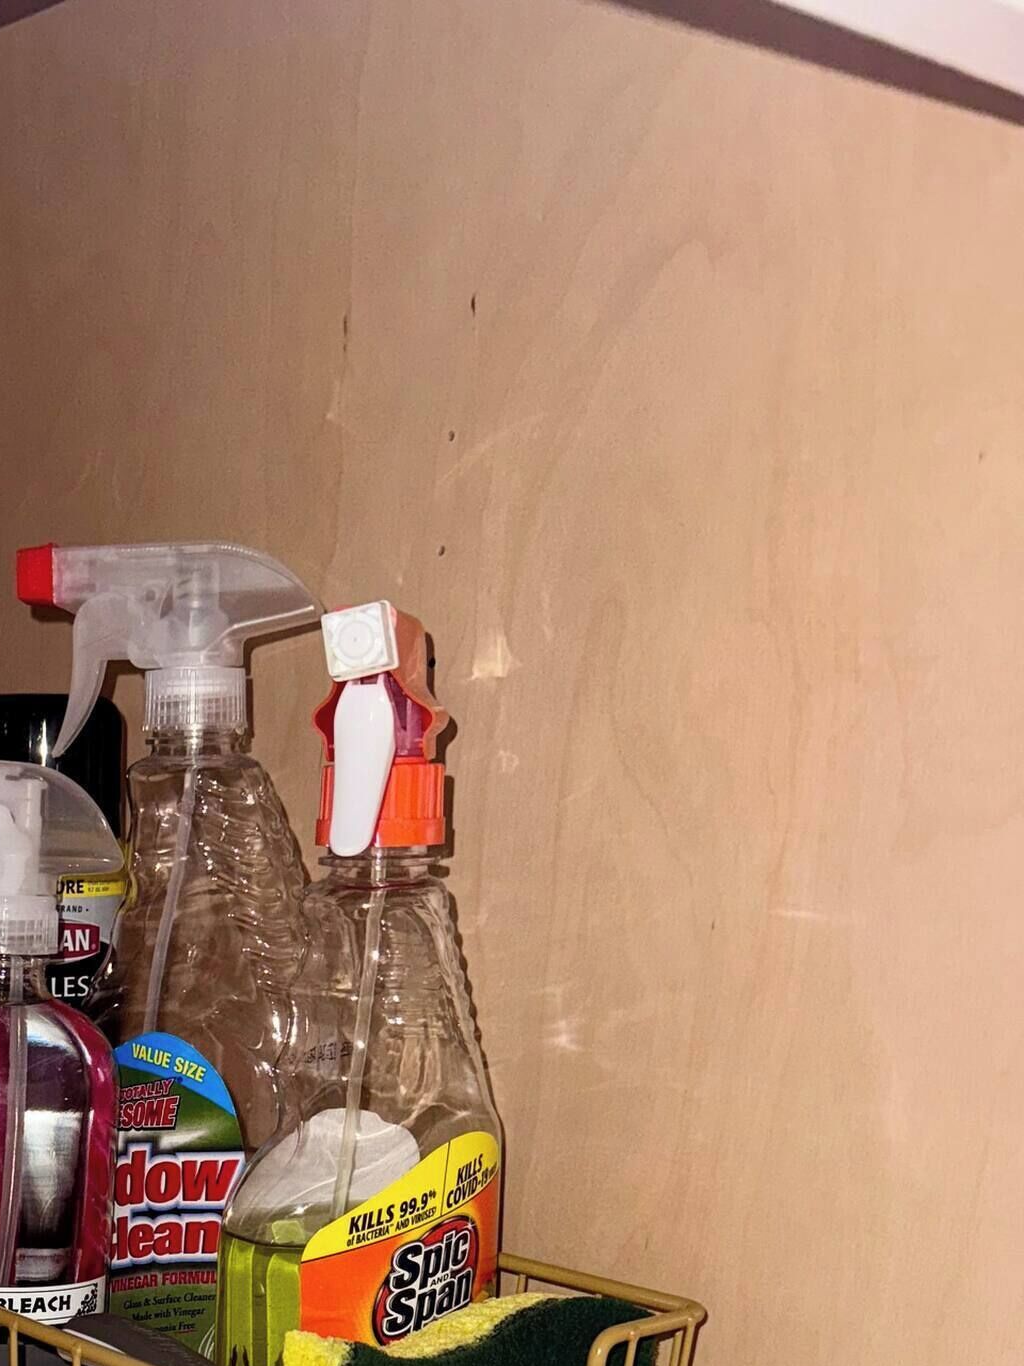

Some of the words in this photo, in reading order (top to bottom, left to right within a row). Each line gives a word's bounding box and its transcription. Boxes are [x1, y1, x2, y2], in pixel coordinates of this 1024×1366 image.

[132, 1043, 172, 1069] VALUE
[173, 1057, 207, 1083] SIZE
[119, 1096, 180, 1128] SOME
[456, 1153, 483, 1187] KILLS
[446, 1167, 489, 1209] COVID-19
[349, 1204, 395, 1235] KILLS
[400, 1189, 437, 1219] 99.9%
[347, 1234, 355, 1247] of
[395, 1218, 410, 1232] AND
[390, 1229, 471, 1292] Spic
[111, 1273, 158, 1293] VINEGAR
[430, 1272, 450, 1287] AND
[144, 1297, 151, 1307] &
[152, 1294, 182, 1306] Surface
[154, 1308, 172, 1319] with
[173, 1306, 206, 1318] Vinegar
[383, 1268, 473, 1335] Span
